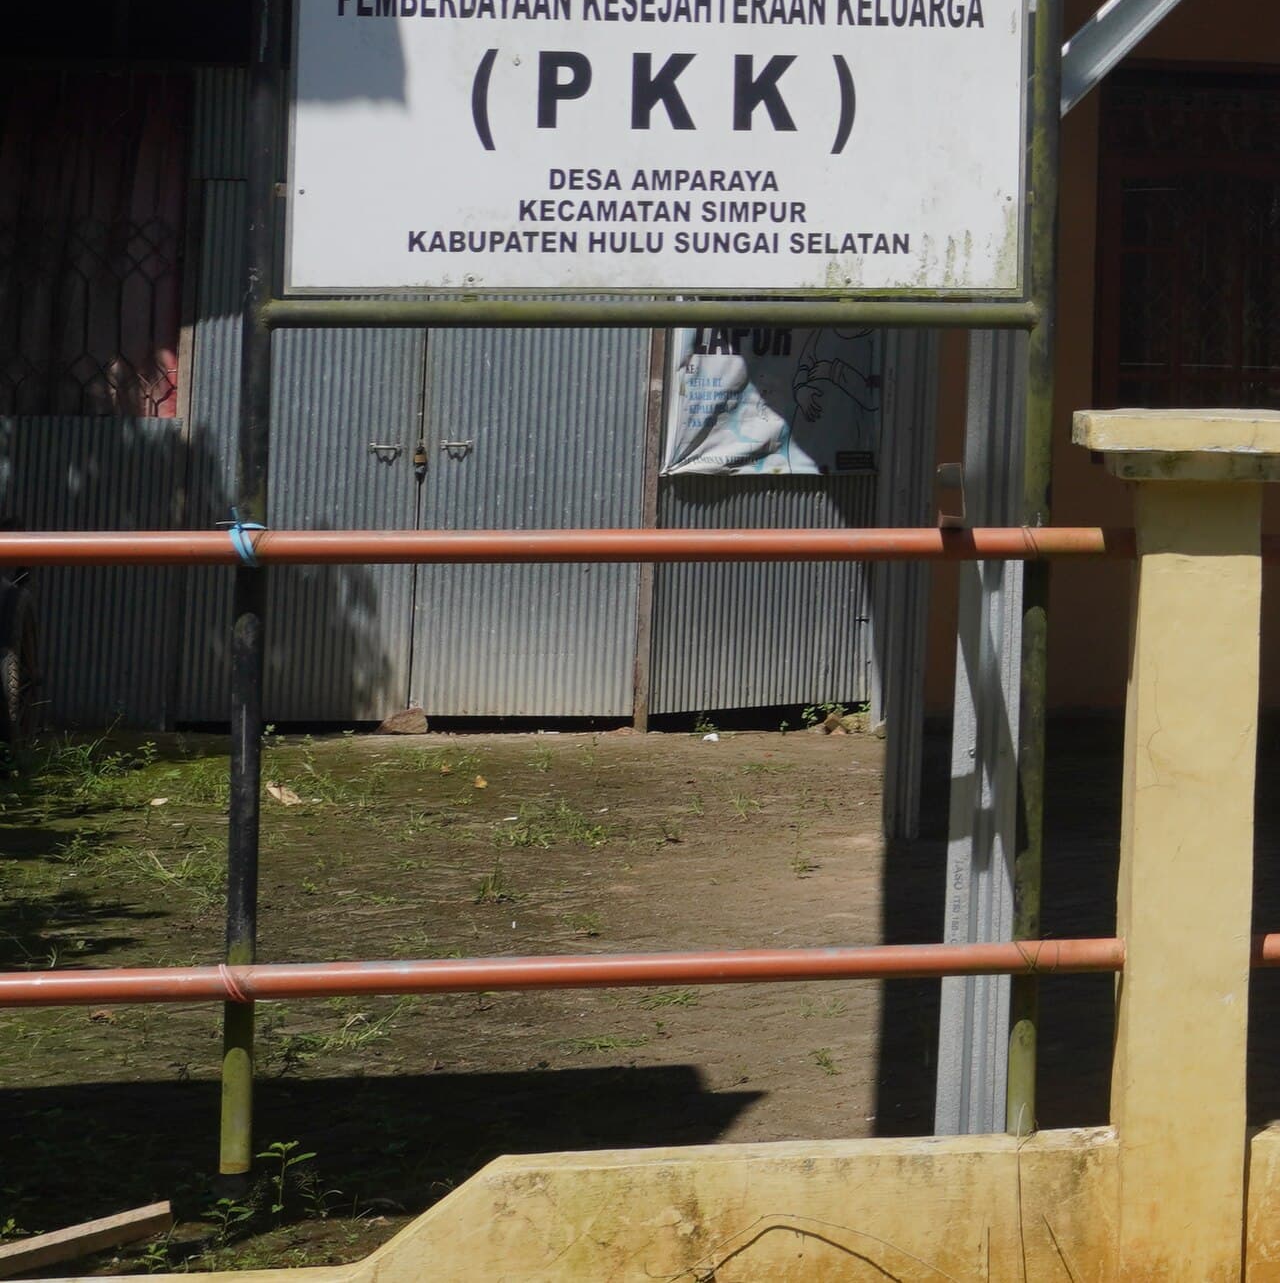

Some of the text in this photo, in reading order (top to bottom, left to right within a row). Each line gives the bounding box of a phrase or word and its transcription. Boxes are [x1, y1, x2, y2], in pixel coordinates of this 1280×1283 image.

[549, 168, 779, 192] DESA AMPARAYA
[519, 199, 807, 223] KECAMATAN SIMPUR
[408, 230, 910, 255] KABUPATEN HULU SUNGAI SELATAN
